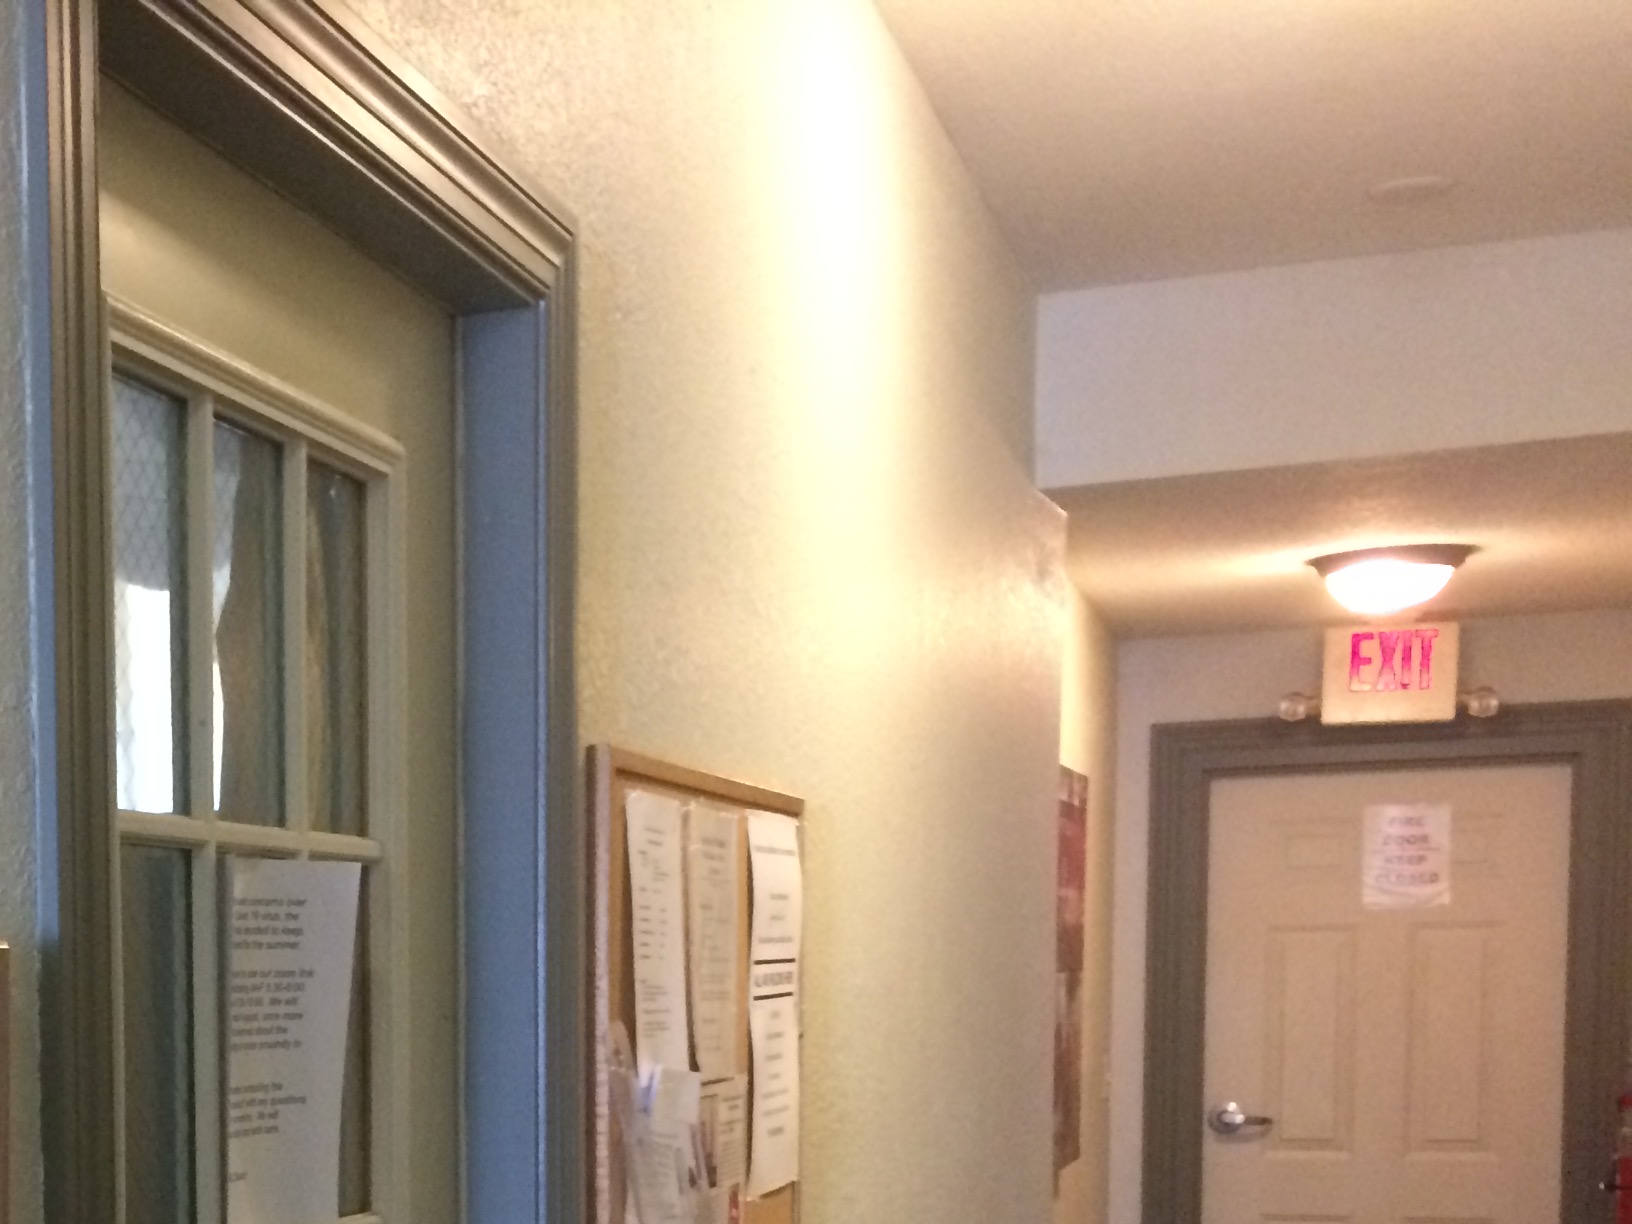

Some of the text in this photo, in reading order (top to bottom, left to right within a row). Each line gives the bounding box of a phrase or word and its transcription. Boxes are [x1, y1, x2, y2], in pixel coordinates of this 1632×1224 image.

[1349, 628, 1439, 691] EXIT
[1382, 834, 1430, 847] DOOR
[1384, 854, 1427, 867] KEEP
[1373, 873, 1439, 887] CLOSED
